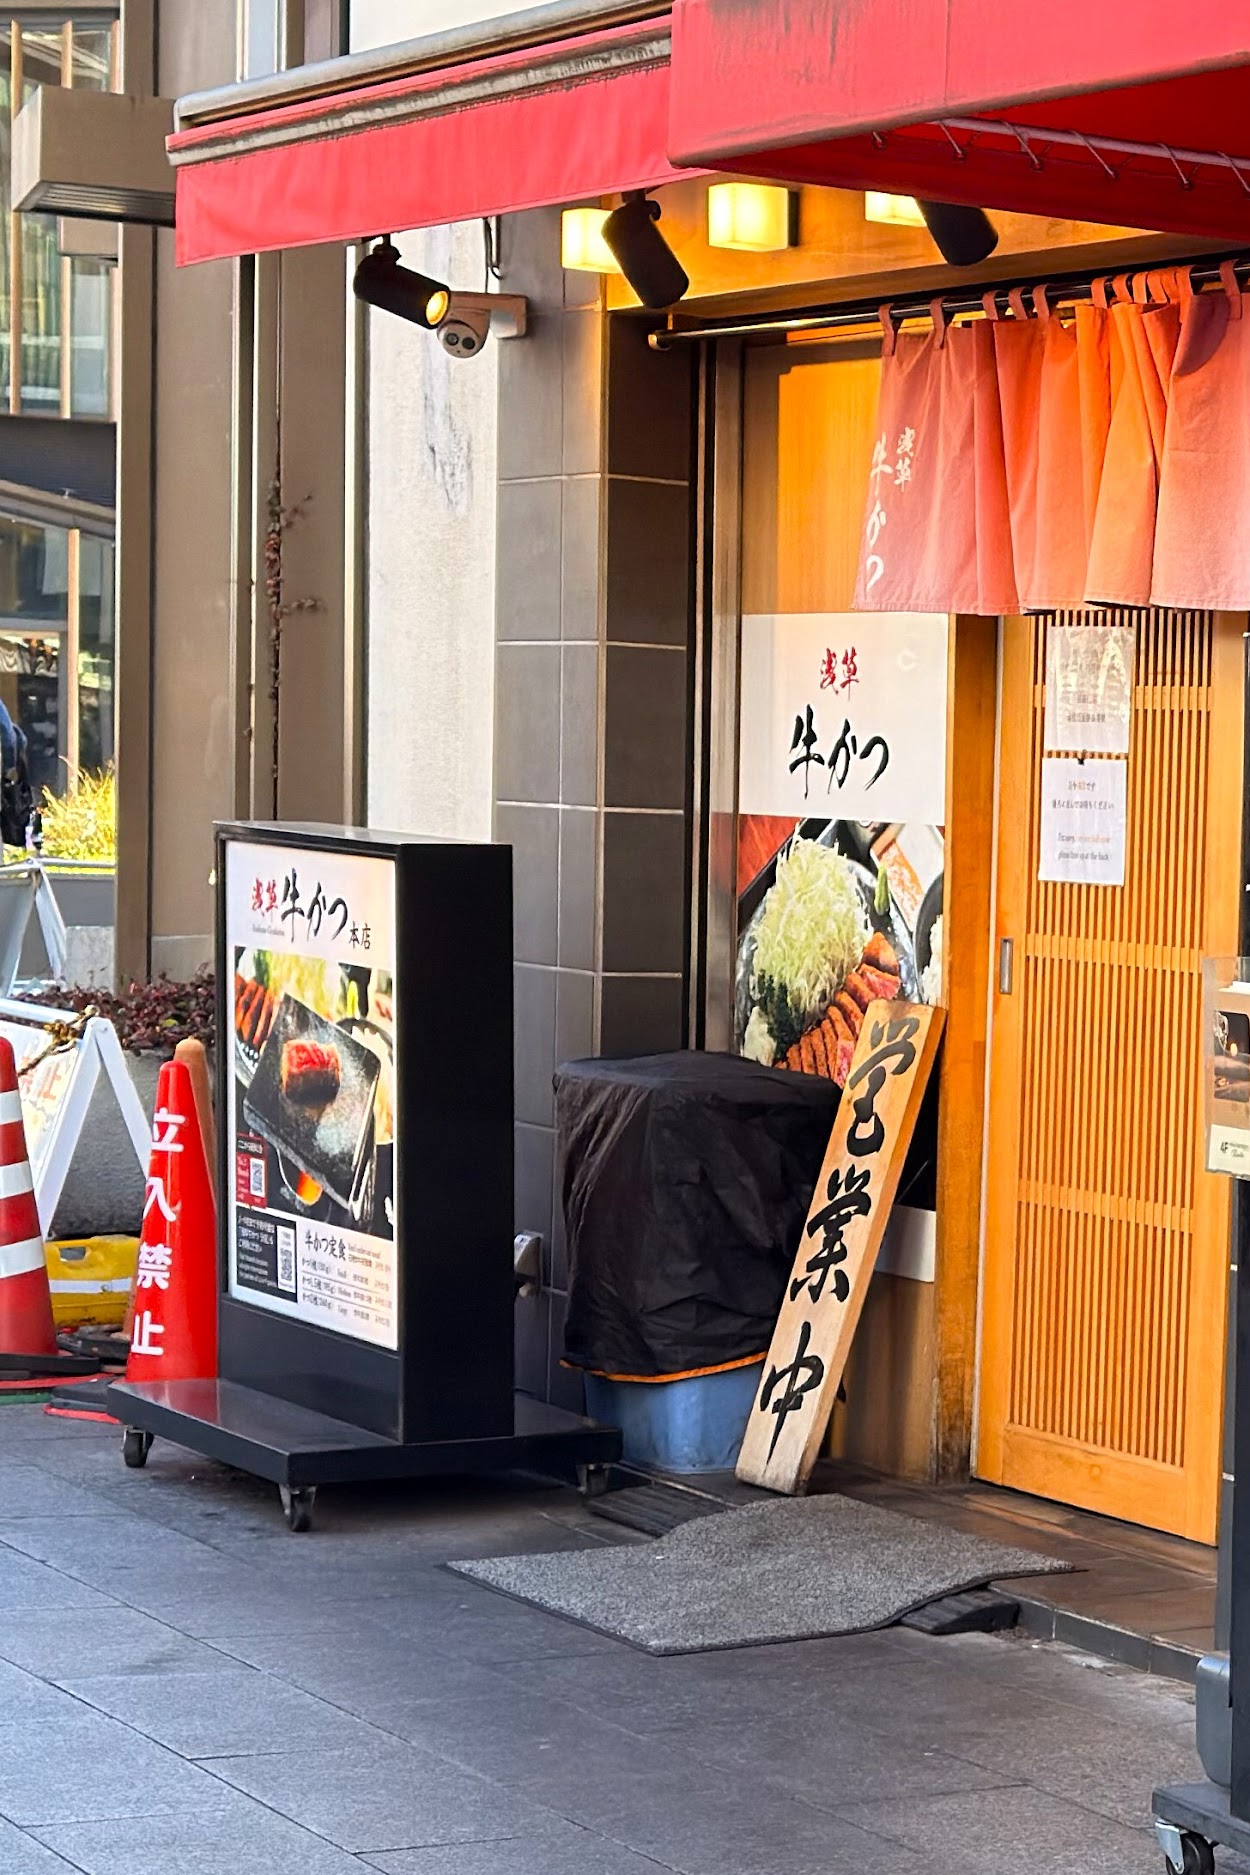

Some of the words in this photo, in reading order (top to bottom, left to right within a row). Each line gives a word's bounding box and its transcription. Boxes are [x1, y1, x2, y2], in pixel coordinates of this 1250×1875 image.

[820, 646, 860, 701] 浅草
[789, 703, 889, 800] 牛かつ
[349, 921, 371, 949] 本店
[132, 1107, 186, 1357] 立入禁止
[760, 1017, 920, 1467] 営業中
